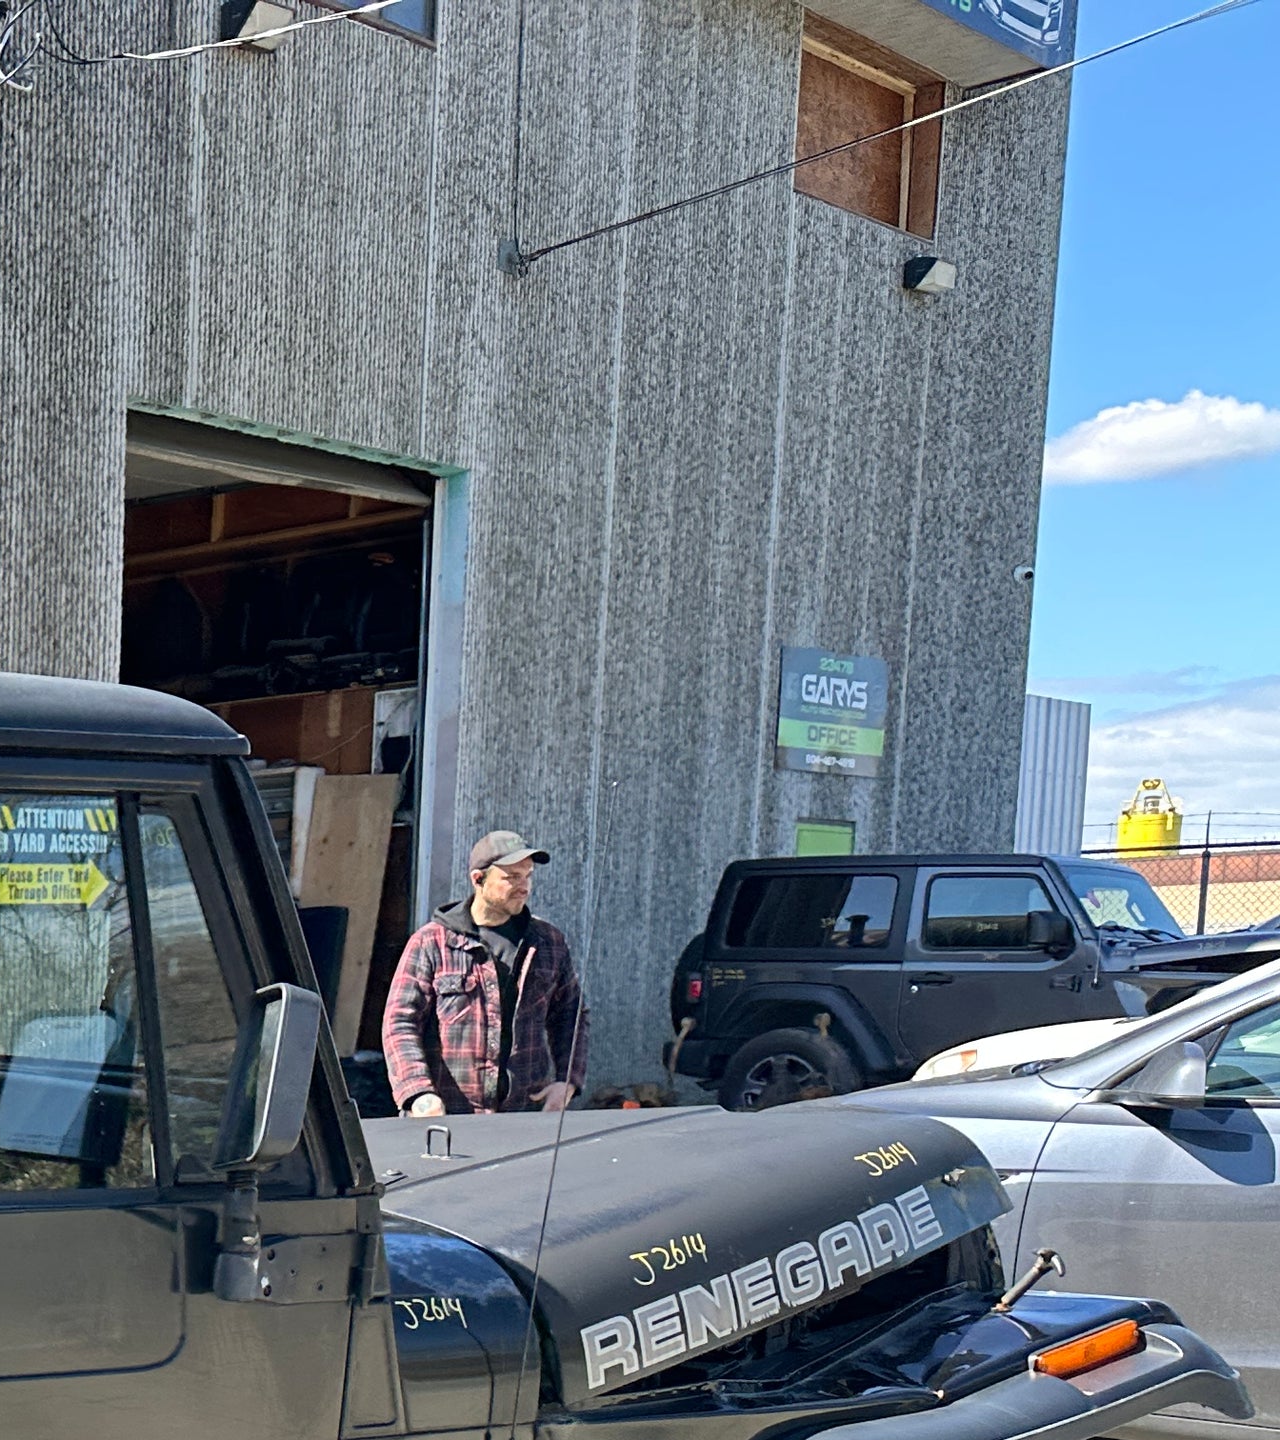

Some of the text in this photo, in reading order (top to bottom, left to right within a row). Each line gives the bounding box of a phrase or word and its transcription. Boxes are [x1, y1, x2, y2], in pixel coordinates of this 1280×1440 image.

[801, 674, 868, 710] GARYS
[808, 725, 857, 746] OFFICE
[17, 808, 84, 829] ATTENTION
[13, 832, 46, 853] YARD
[0, 867, 89, 883] Please Enter Yard
[8, 886, 48, 902] Through
[854, 1141, 918, 1177] J2614
[629, 1232, 709, 1286] J2614
[580, 1184, 944, 1390] RENEGADE
[394, 1297, 468, 1330] J2614
